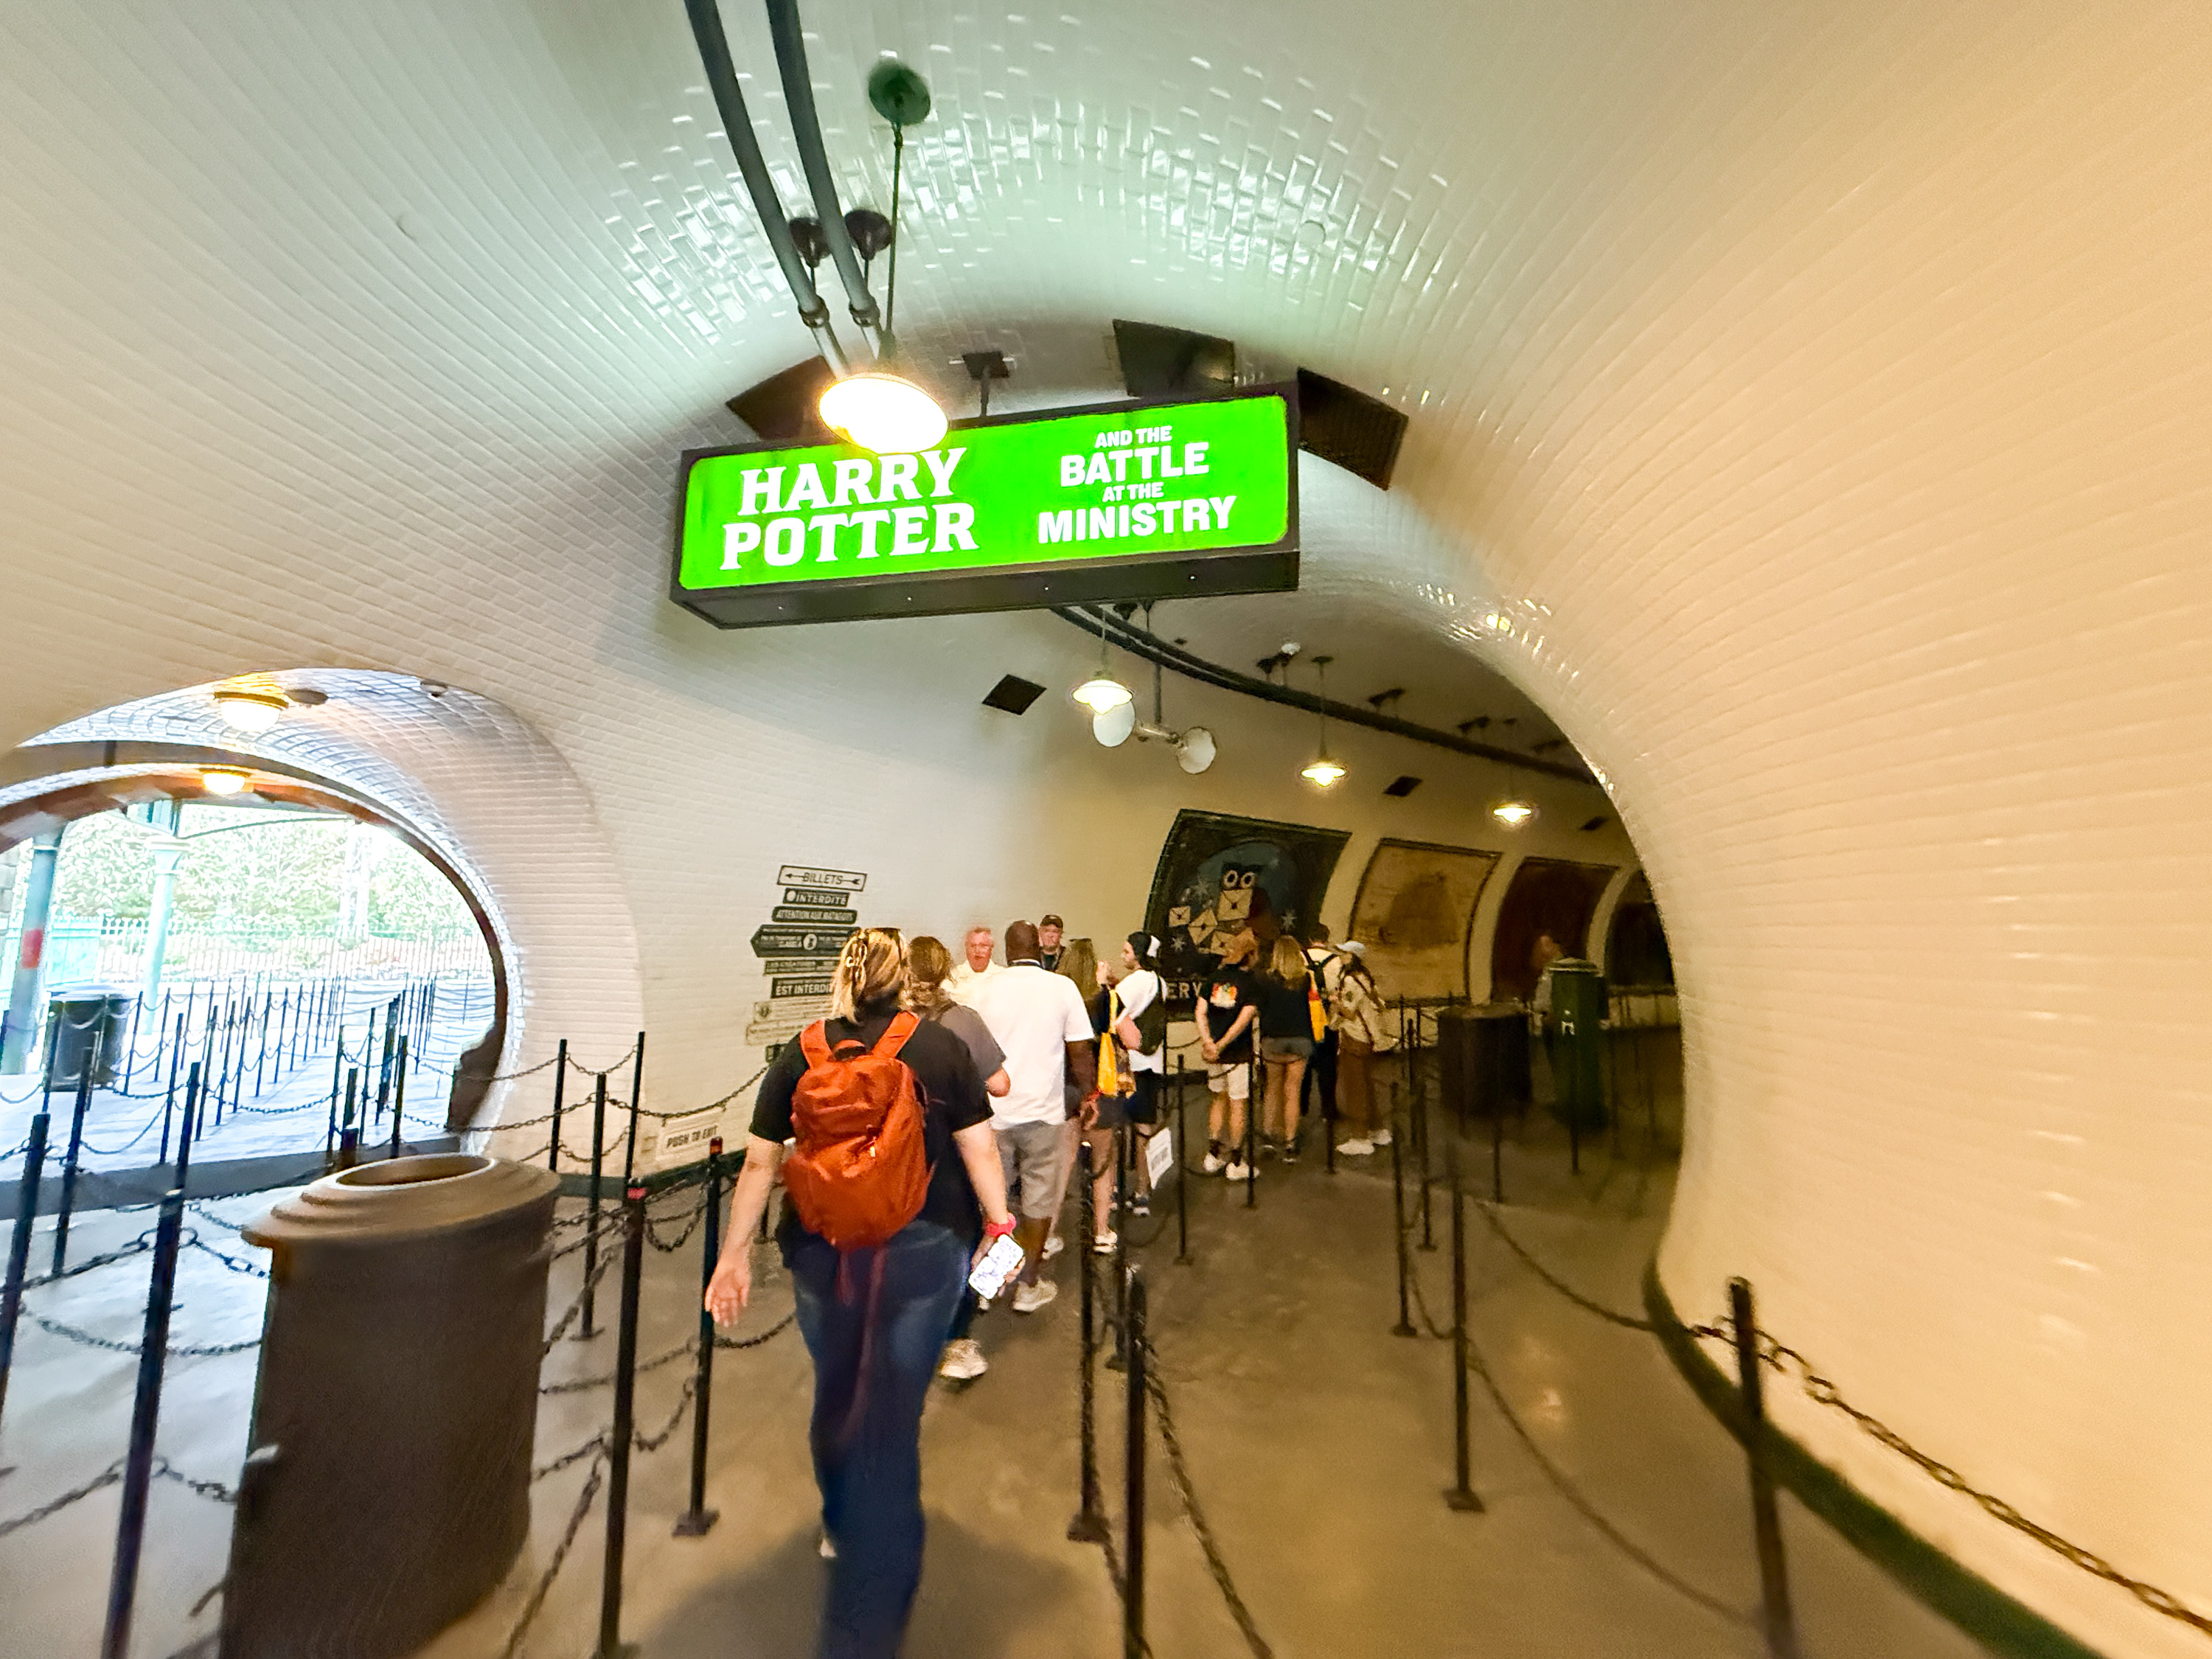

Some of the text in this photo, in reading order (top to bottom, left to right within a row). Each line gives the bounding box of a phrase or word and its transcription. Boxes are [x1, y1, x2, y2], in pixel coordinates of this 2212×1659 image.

[1095, 425, 1172, 448] AND THE
[1060, 442, 1210, 487] BATTLE
[739, 447, 967, 516] HARRY
[1102, 481, 1164, 503] AT THE
[1038, 495, 1237, 544] MINISTRY
[720, 502, 979, 571] POTTER
[802, 872, 843, 885] BILLETS
[796, 893, 847, 905] INTERDITE
[775, 985, 793, 996] EST
